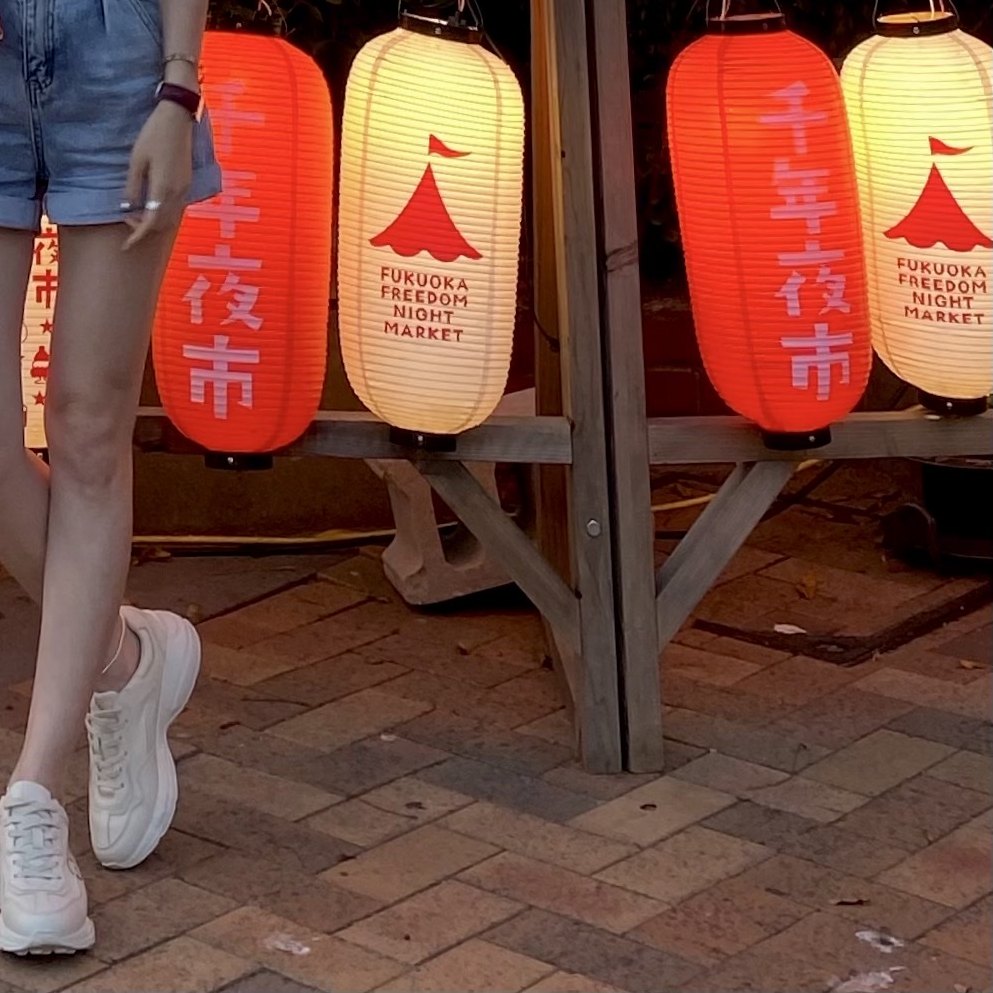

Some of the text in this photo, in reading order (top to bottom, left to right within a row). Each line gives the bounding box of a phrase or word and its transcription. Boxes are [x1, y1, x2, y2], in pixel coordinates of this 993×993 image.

[181, 79, 265, 419] 千年夜市
[758, 80, 854, 402] 千年夜市
[896, 257, 987, 278] FUKUOKA
[380, 266, 469, 291] FUKUOKA
[898, 273, 987, 294] FREEDOM
[381, 285, 468, 307] FREEDOM
[912, 291, 974, 309] NIGHT
[393, 304, 455, 324] NIGHT
[904, 305, 985, 325] MARKET
[383, 320, 464, 342] MARKET
